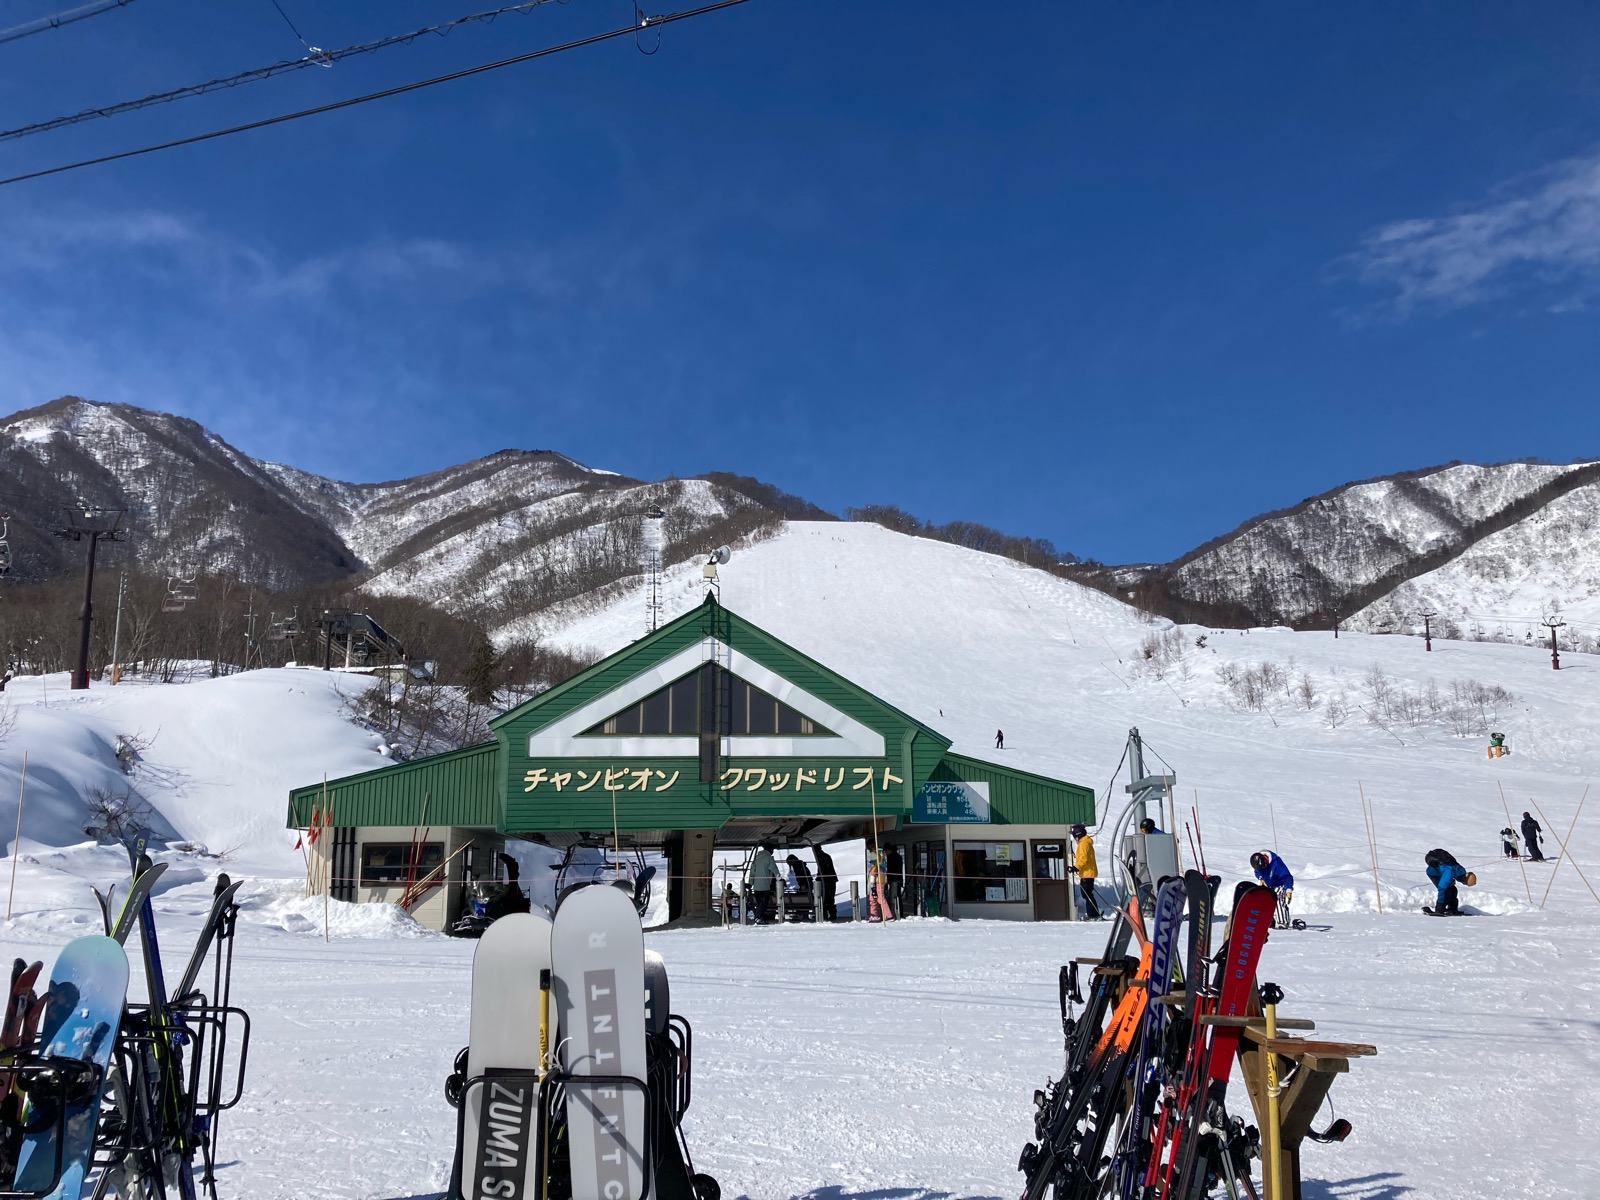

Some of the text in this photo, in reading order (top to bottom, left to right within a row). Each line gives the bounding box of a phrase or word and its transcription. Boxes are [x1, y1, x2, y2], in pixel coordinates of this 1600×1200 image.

[524, 767, 903, 792] チャンピオン クワッドリフト
[121, 892, 142, 934] HEAD
[1239, 910, 1260, 966] OGASAKA
[481, 1082, 524, 1200] ZUMA S
